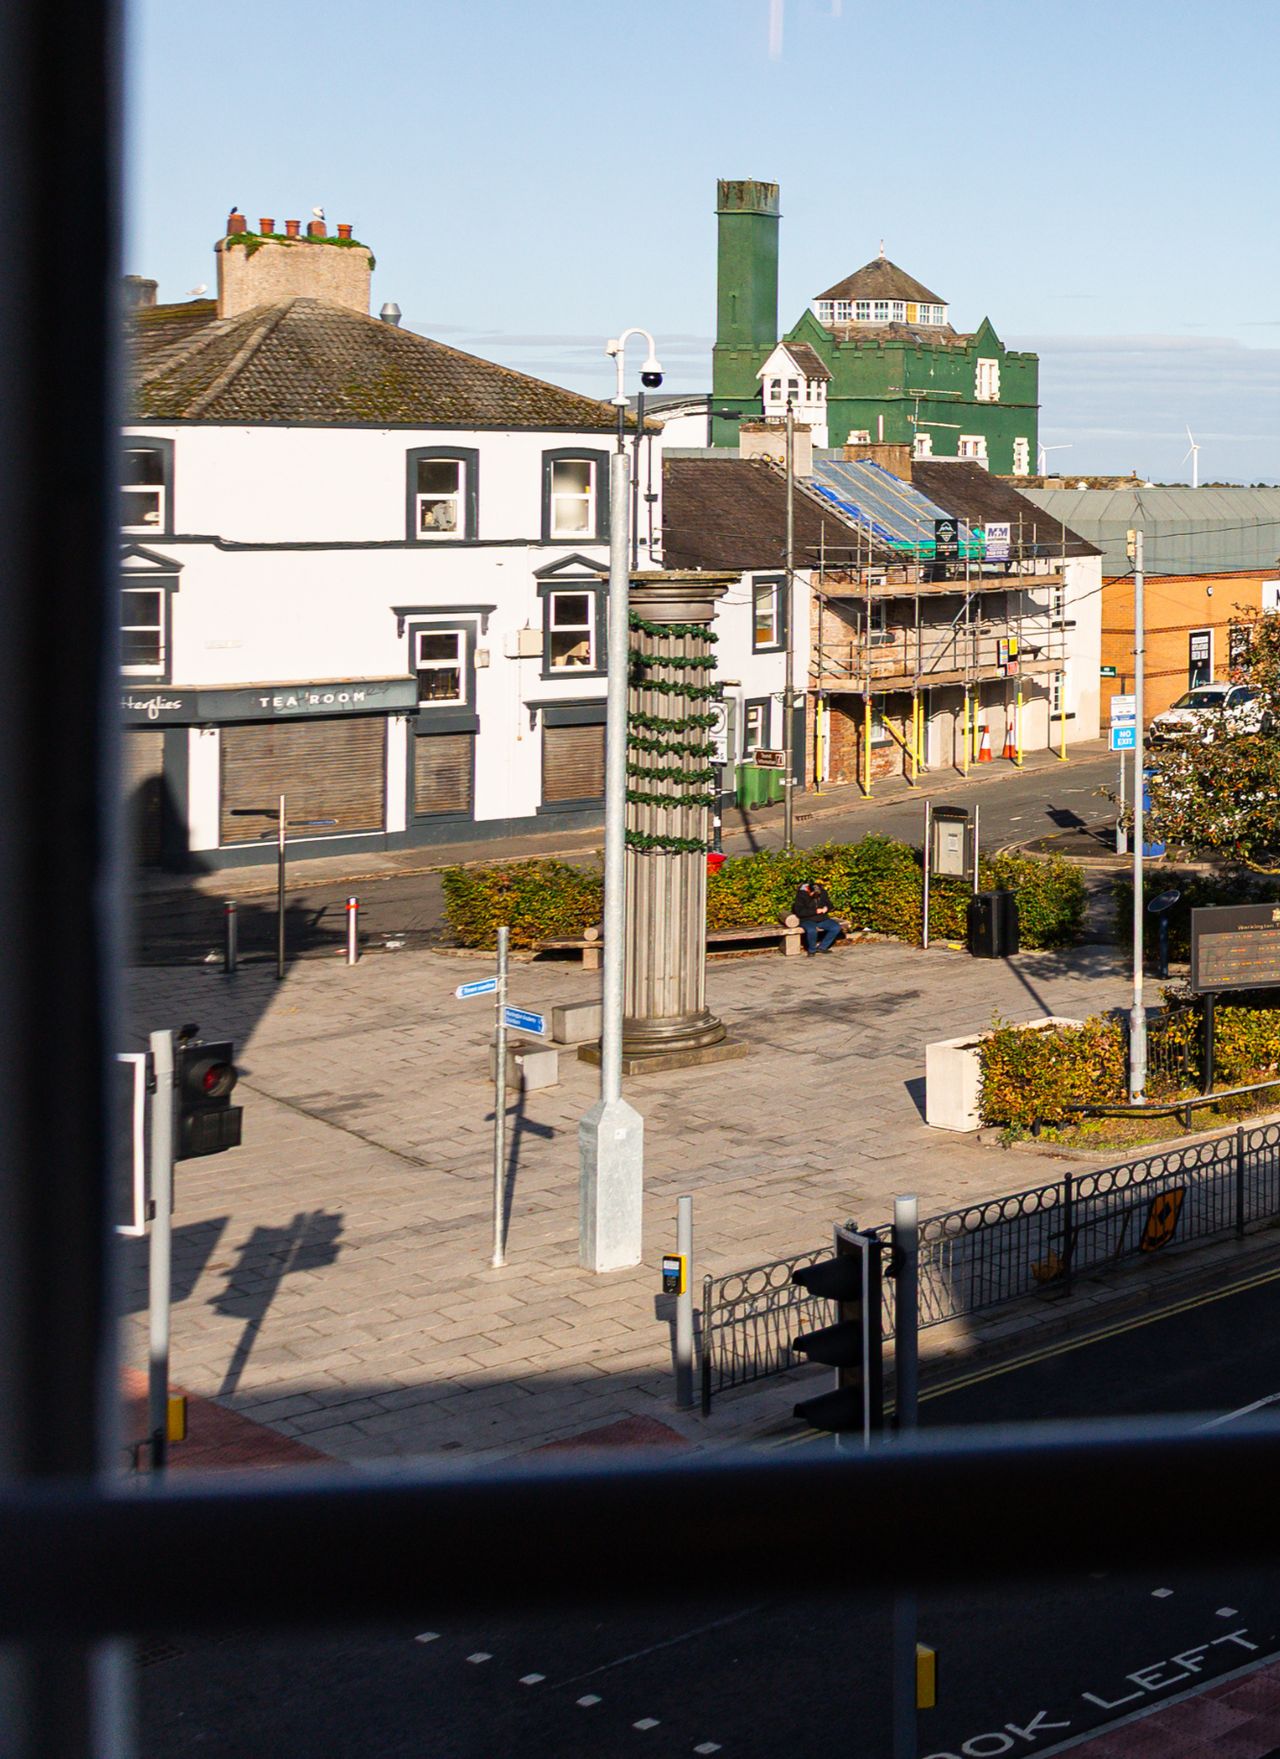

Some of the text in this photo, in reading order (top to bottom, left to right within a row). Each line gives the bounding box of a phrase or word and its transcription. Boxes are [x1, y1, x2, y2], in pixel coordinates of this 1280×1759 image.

[259, 691, 366, 709] TEA ROOM
[1119, 730, 1132, 738] NO
[1117, 738, 1133, 746] EXIT
[922, 1629, 1260, 1759] OK LEFT
